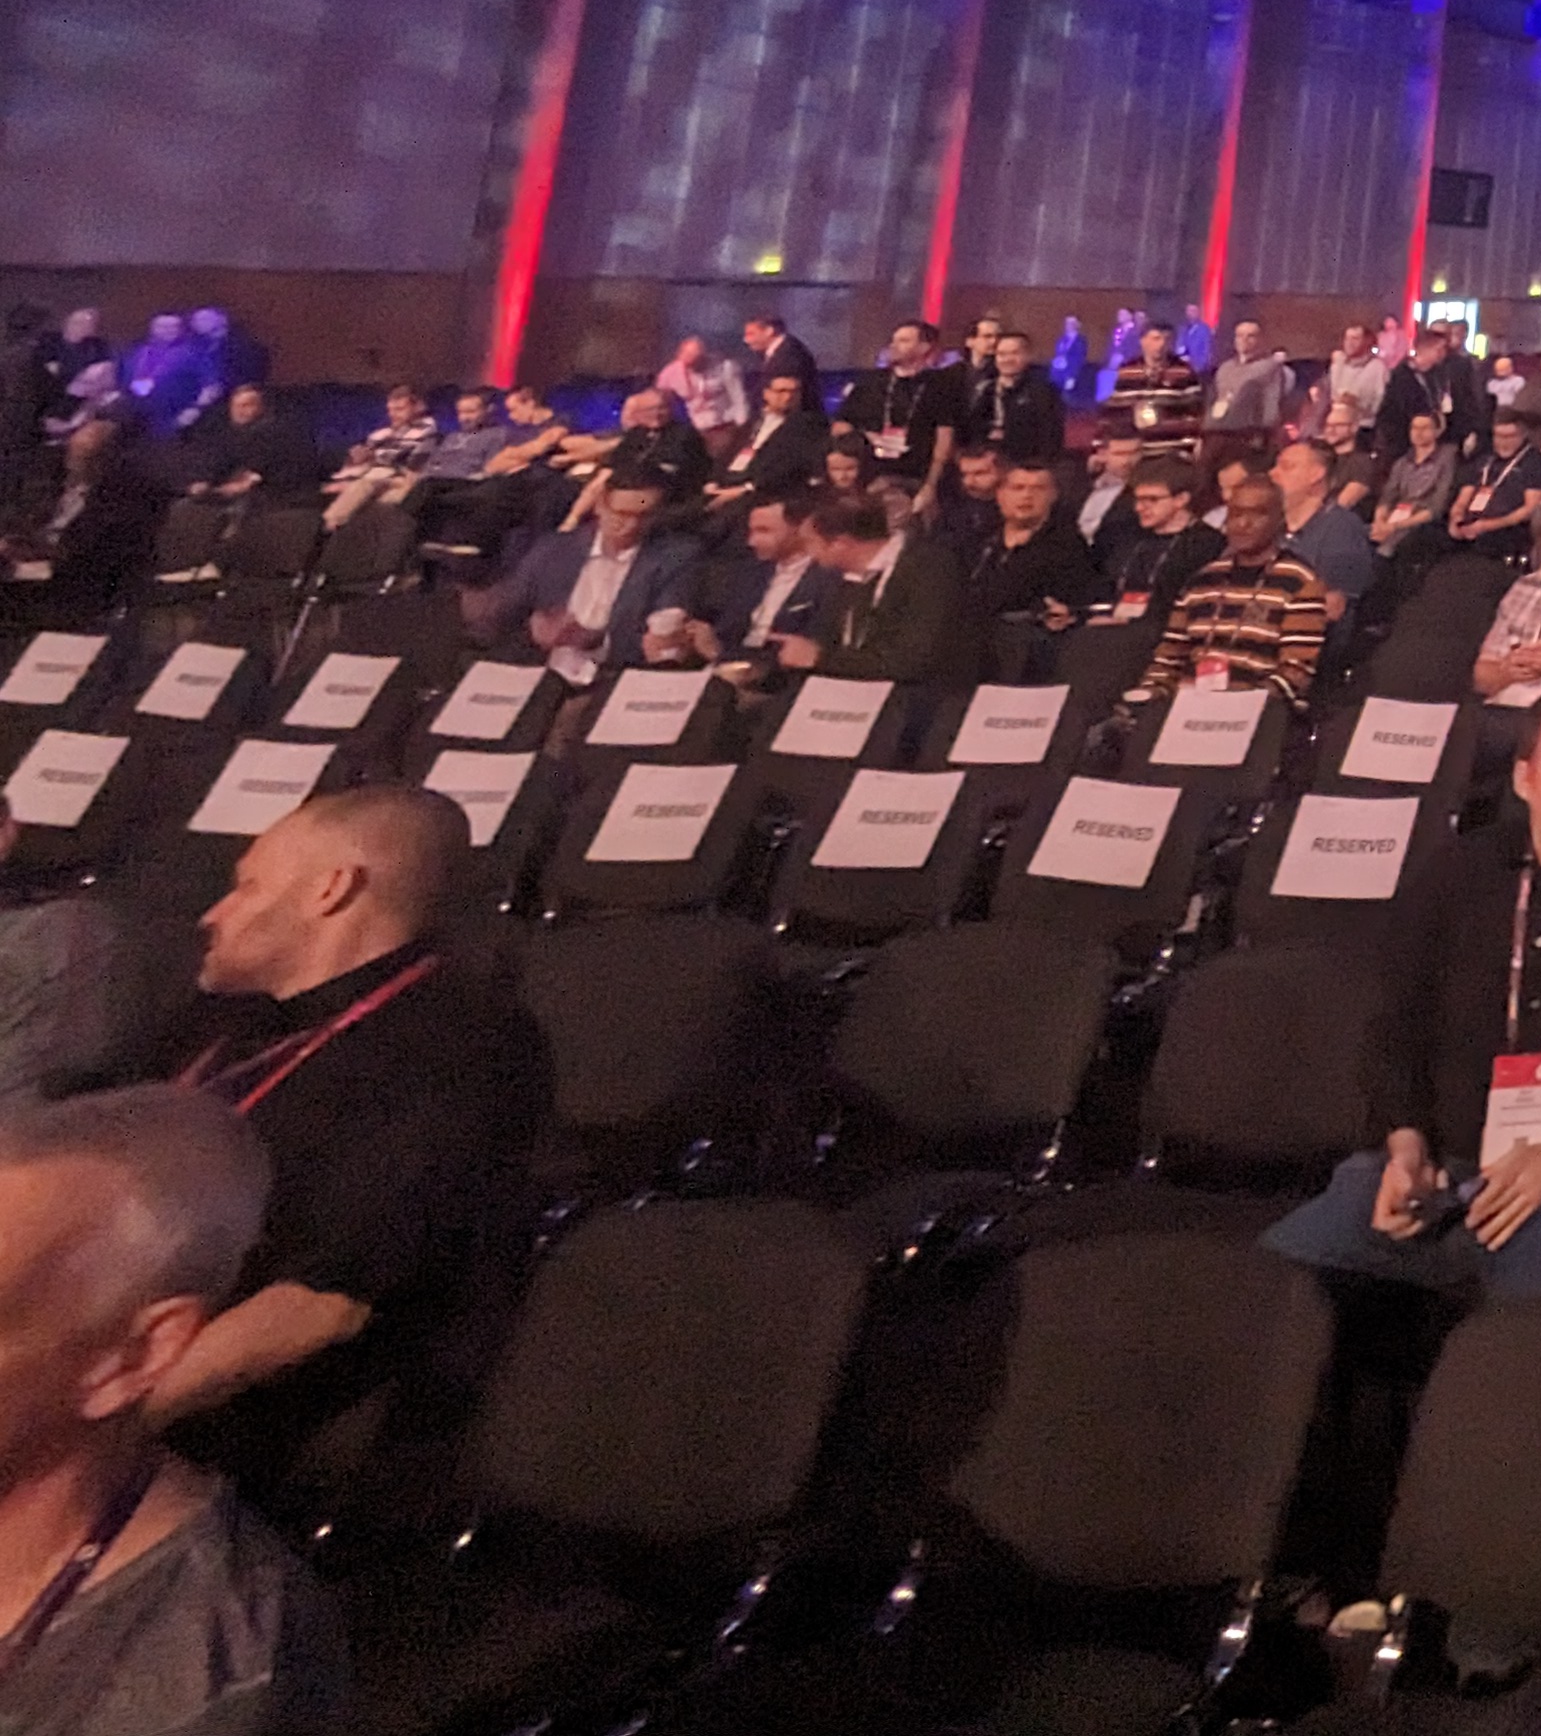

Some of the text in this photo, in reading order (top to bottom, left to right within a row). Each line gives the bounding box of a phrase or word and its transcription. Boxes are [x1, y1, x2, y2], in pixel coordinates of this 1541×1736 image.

[1372, 730, 1437, 747] RESERVED
[1072, 819, 1155, 842] RESERVED
[1311, 837, 1397, 853] RESERVED
